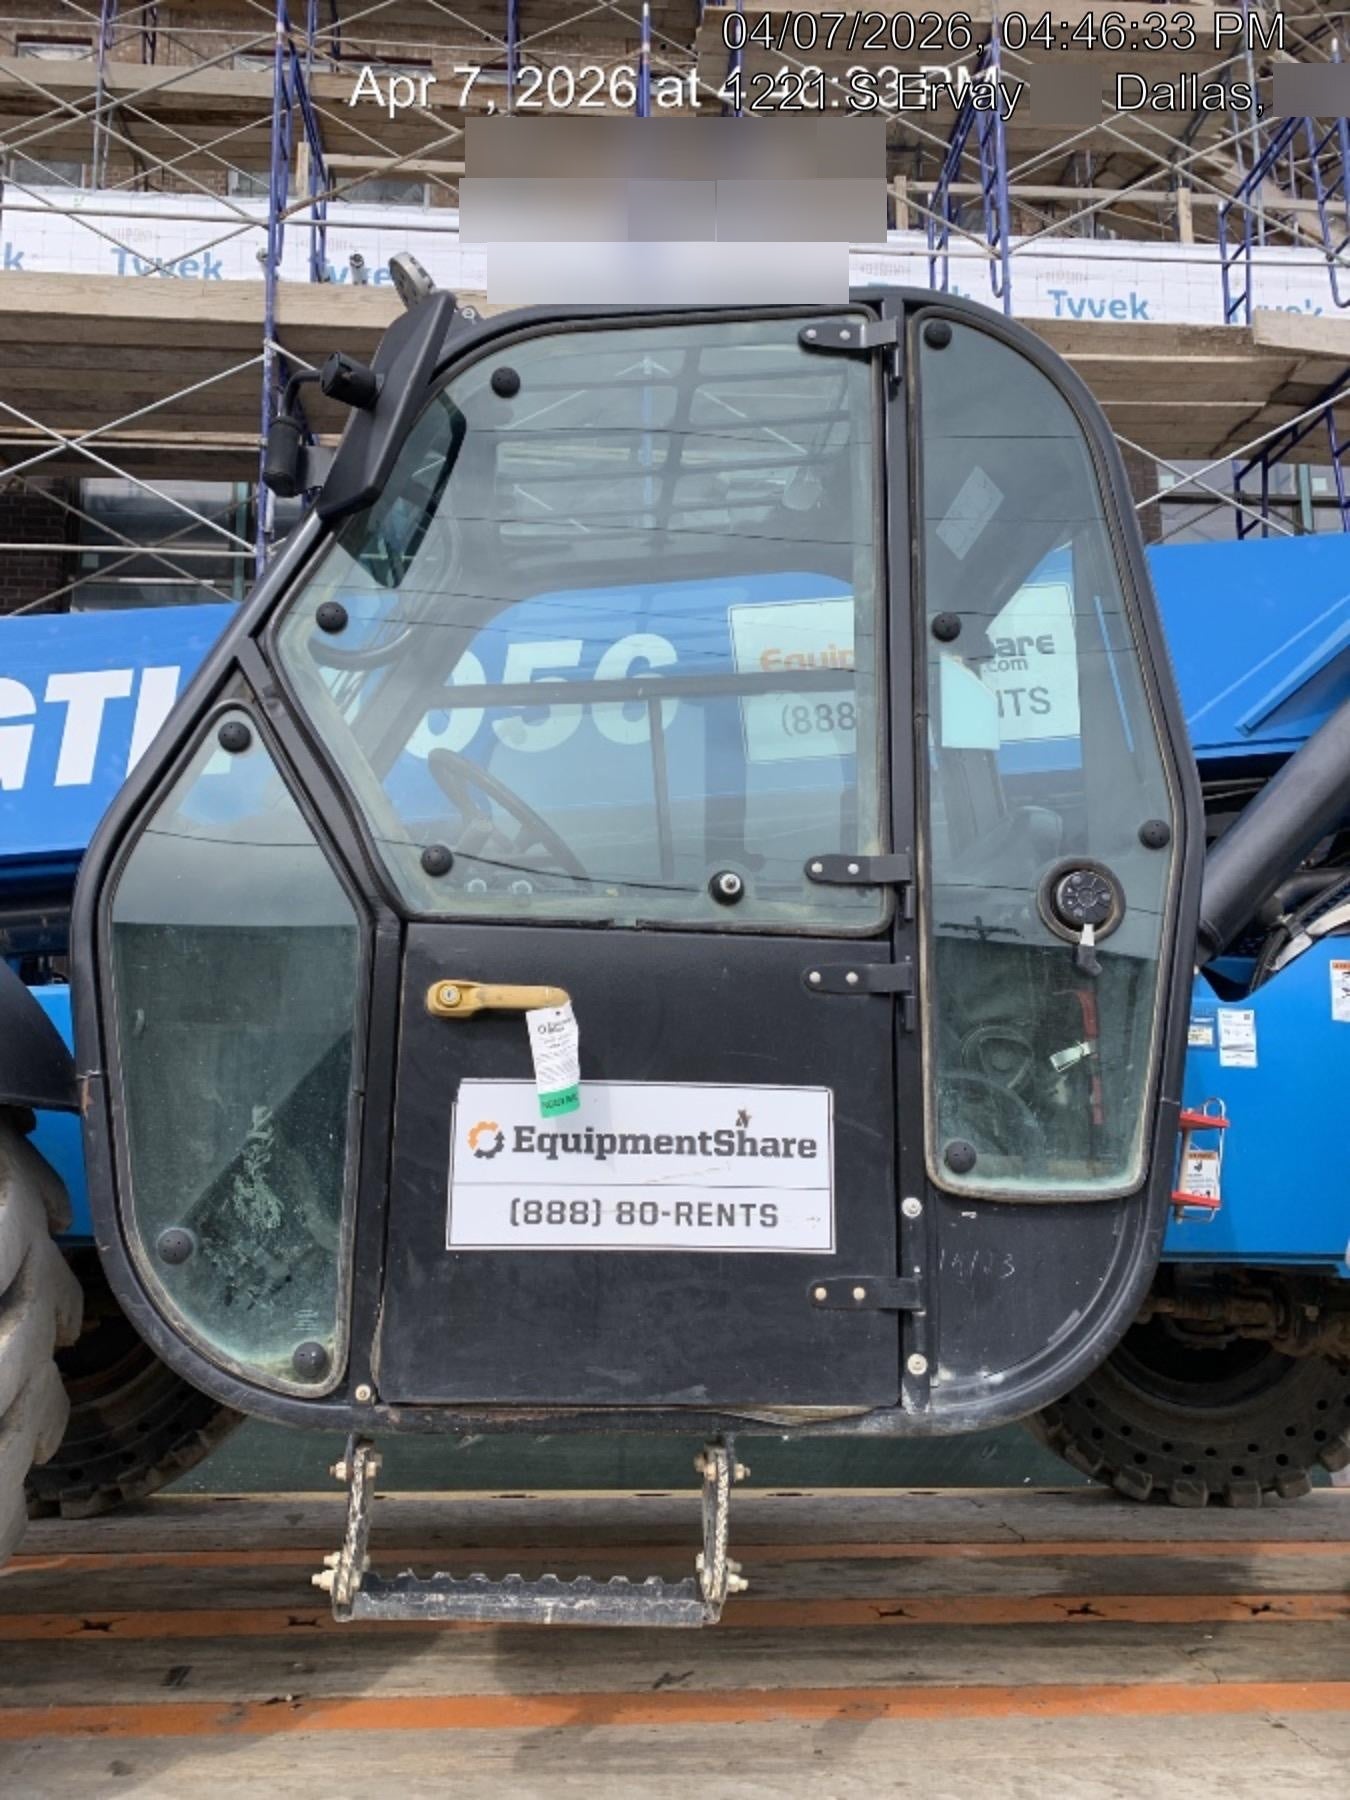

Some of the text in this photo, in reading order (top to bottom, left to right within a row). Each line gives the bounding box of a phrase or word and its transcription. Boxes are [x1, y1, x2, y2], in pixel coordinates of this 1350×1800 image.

[512, 1126, 818, 1160] EquipmentShare
[510, 1198, 779, 1227] (888) 80-RENTS
